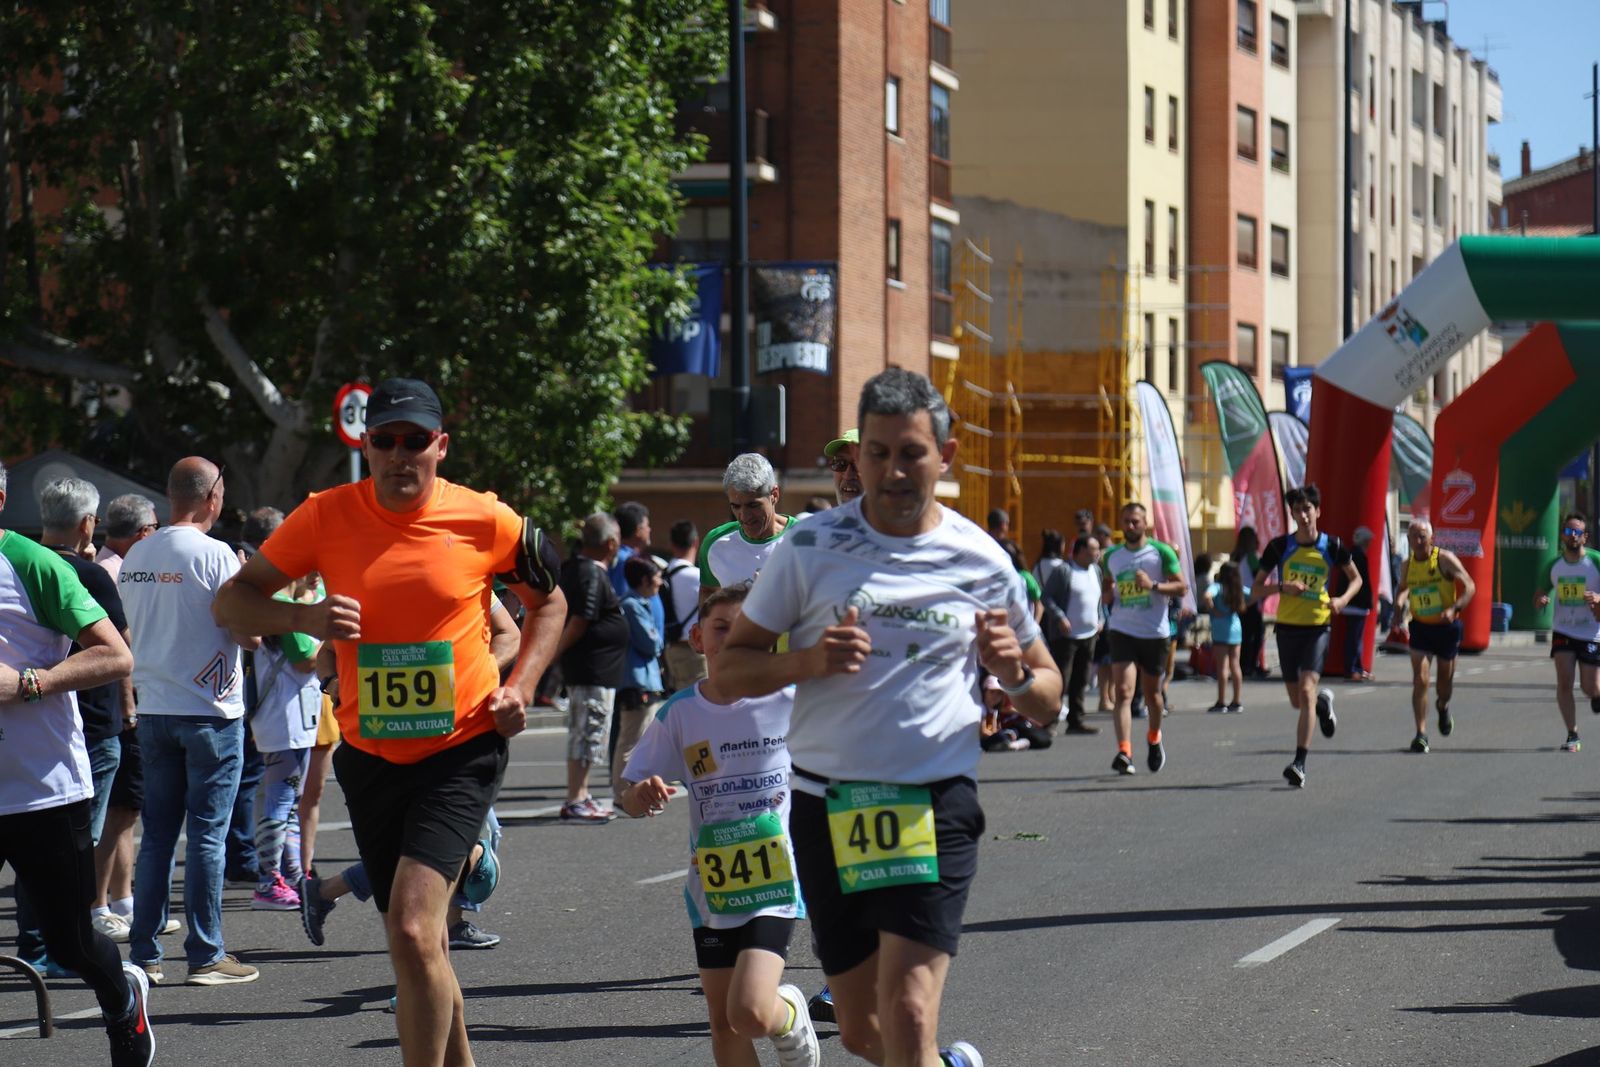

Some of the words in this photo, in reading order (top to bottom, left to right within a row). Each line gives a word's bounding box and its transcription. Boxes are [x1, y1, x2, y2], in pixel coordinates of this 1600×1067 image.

[344, 404, 367, 425] 3
[121, 572, 156, 583] ZAMORA
[158, 573, 183, 583] NEWS
[364, 670, 436, 708] 159
[386, 721, 413, 731] CAJA
[415, 718, 451, 730] RURAL
[714, 832, 733, 842] CAJA
[733, 828, 758, 839] RURAL
[848, 810, 901, 854] 40
[704, 844, 772, 888] 341
[861, 867, 888, 881] CAJA
[889, 862, 932, 877] RURAL
[728, 896, 754, 906] CAJA
[754, 887, 792, 903] RURAL
